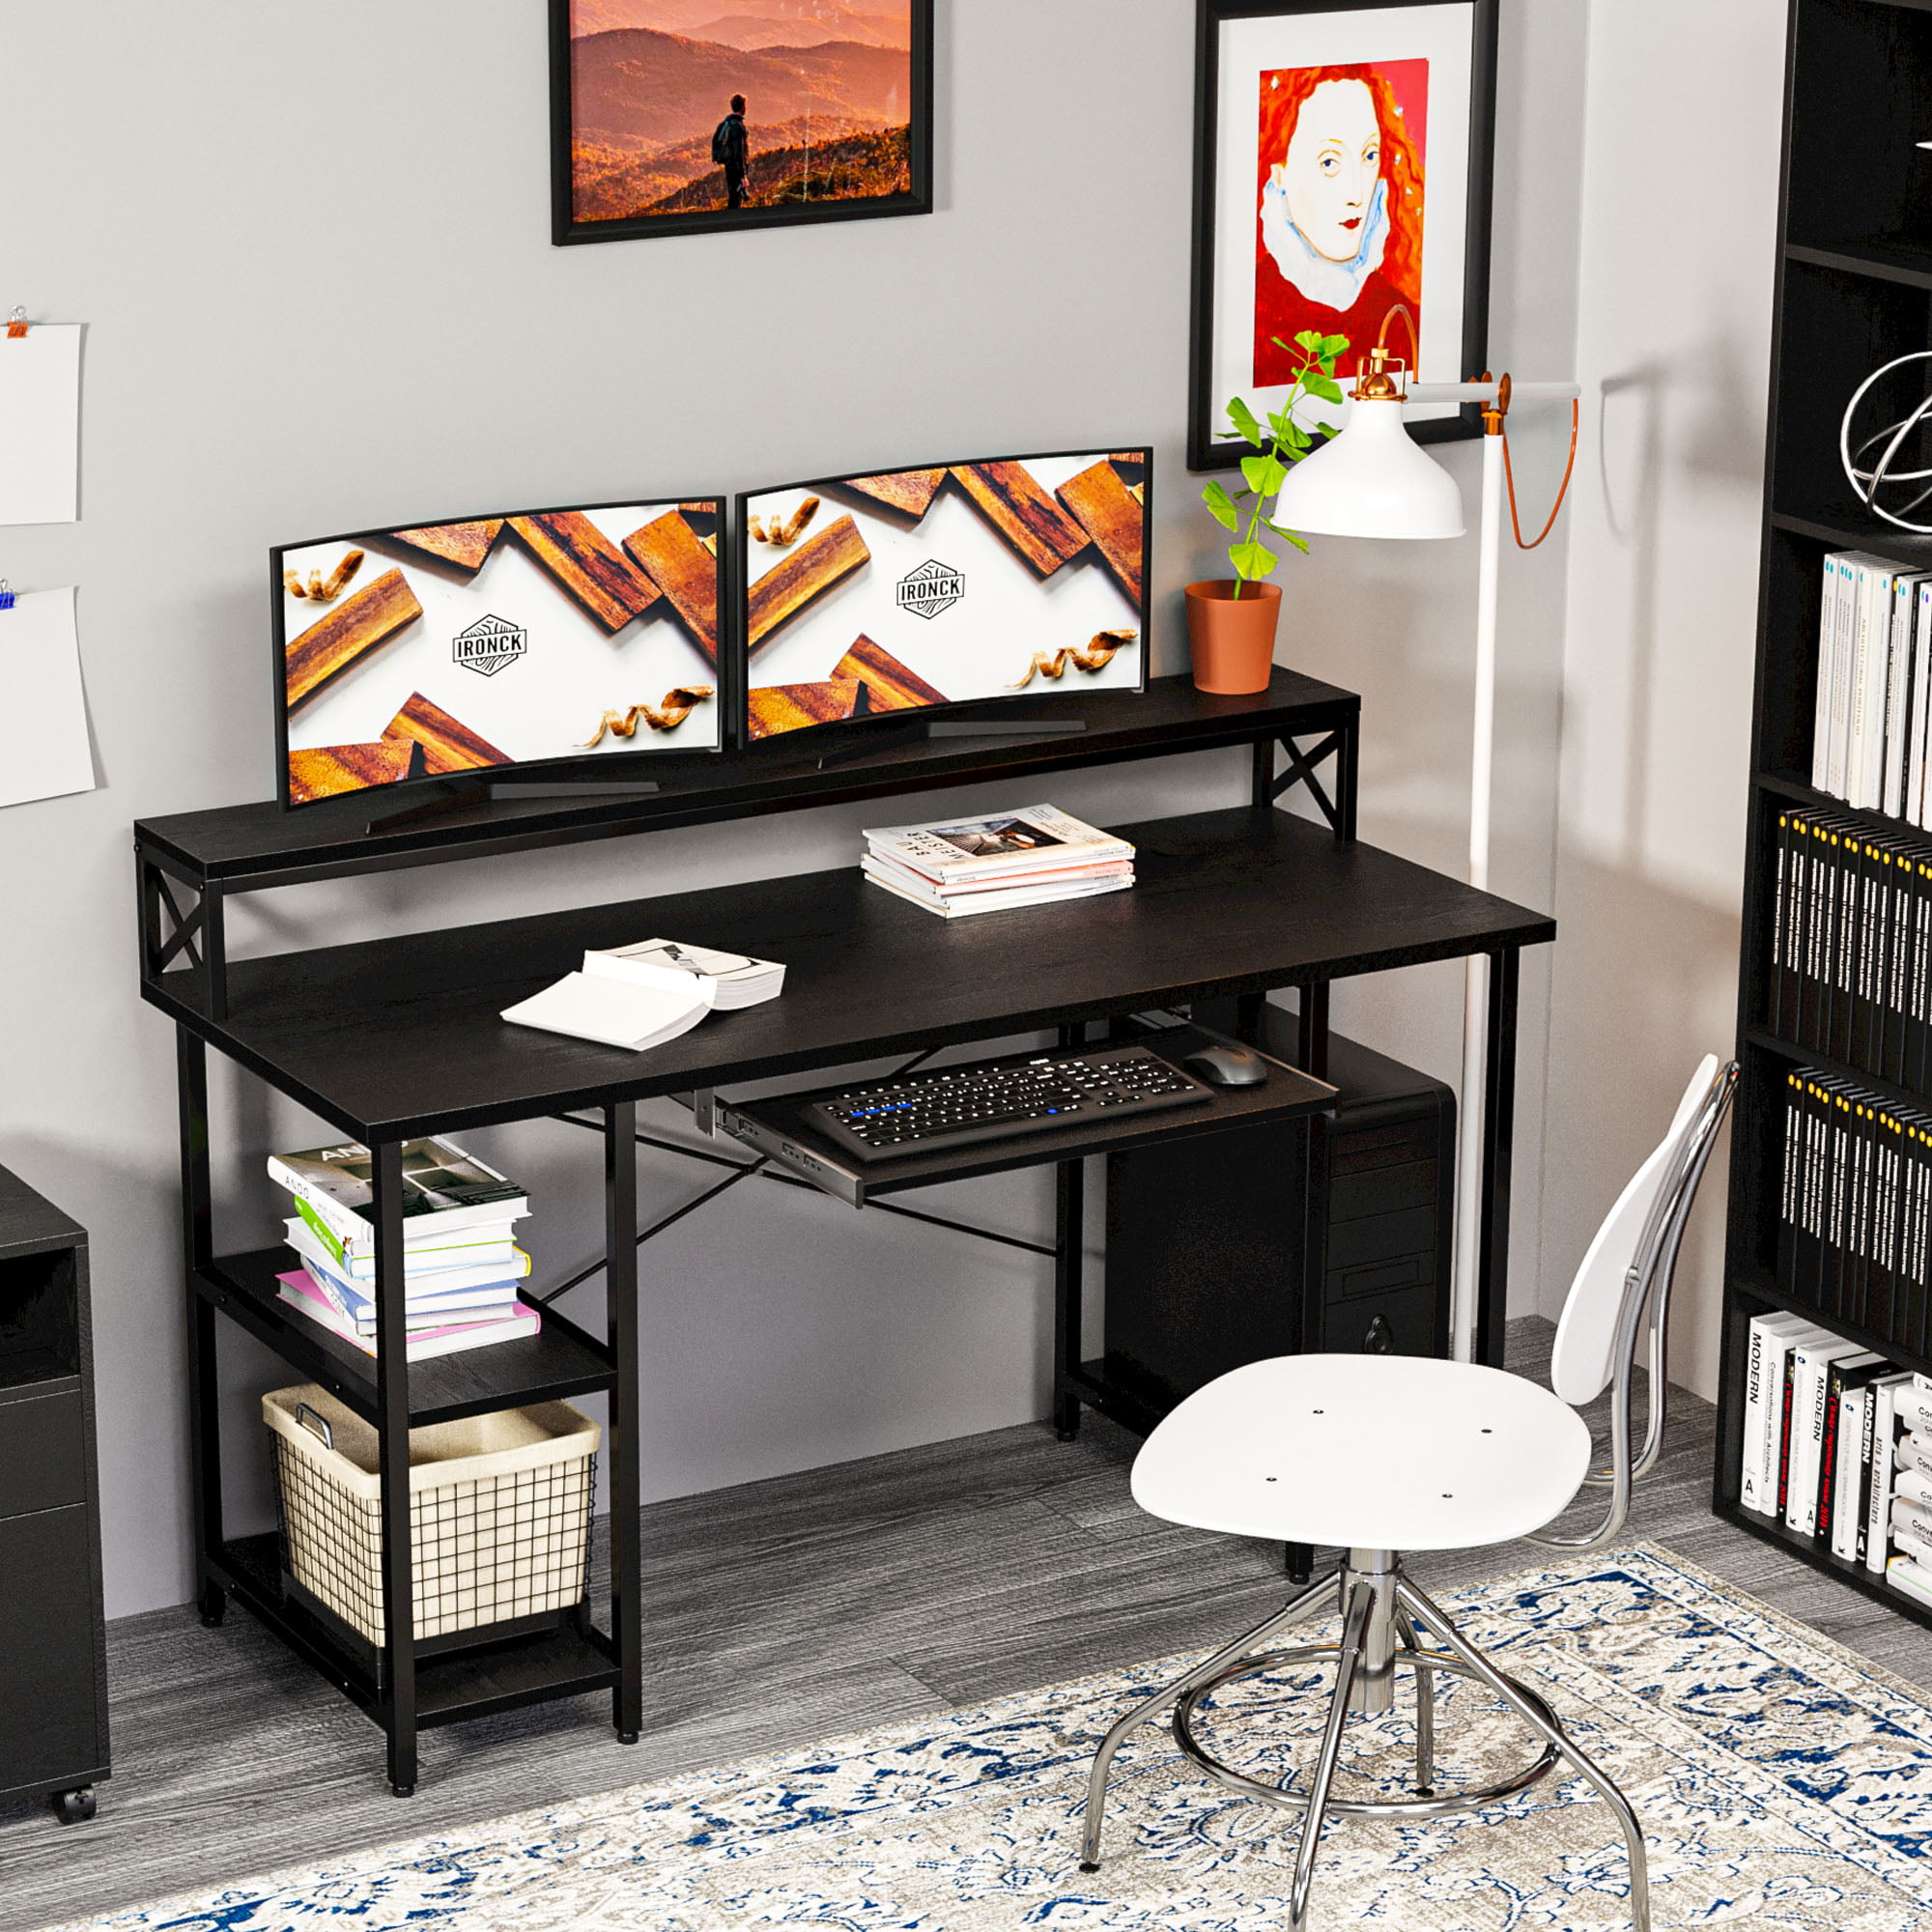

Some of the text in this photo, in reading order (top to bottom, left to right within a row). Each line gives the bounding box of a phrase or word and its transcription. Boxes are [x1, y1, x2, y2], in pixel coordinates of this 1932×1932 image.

[901, 578, 960, 601] IRONCK
[458, 634, 522, 658] IRONCK
[285, 1175, 309, 1200] ANDO
[1749, 1332, 1762, 1405] MODERN
[1767, 1361, 1776, 1421] Conversations
[1813, 1376, 1825, 1441] MODERN
[1861, 1391, 1874, 1463] MODERN
[1745, 1479, 1753, 1493] A
[1807, 1510, 1814, 1523] A
[1857, 1536, 1864, 1552] A
